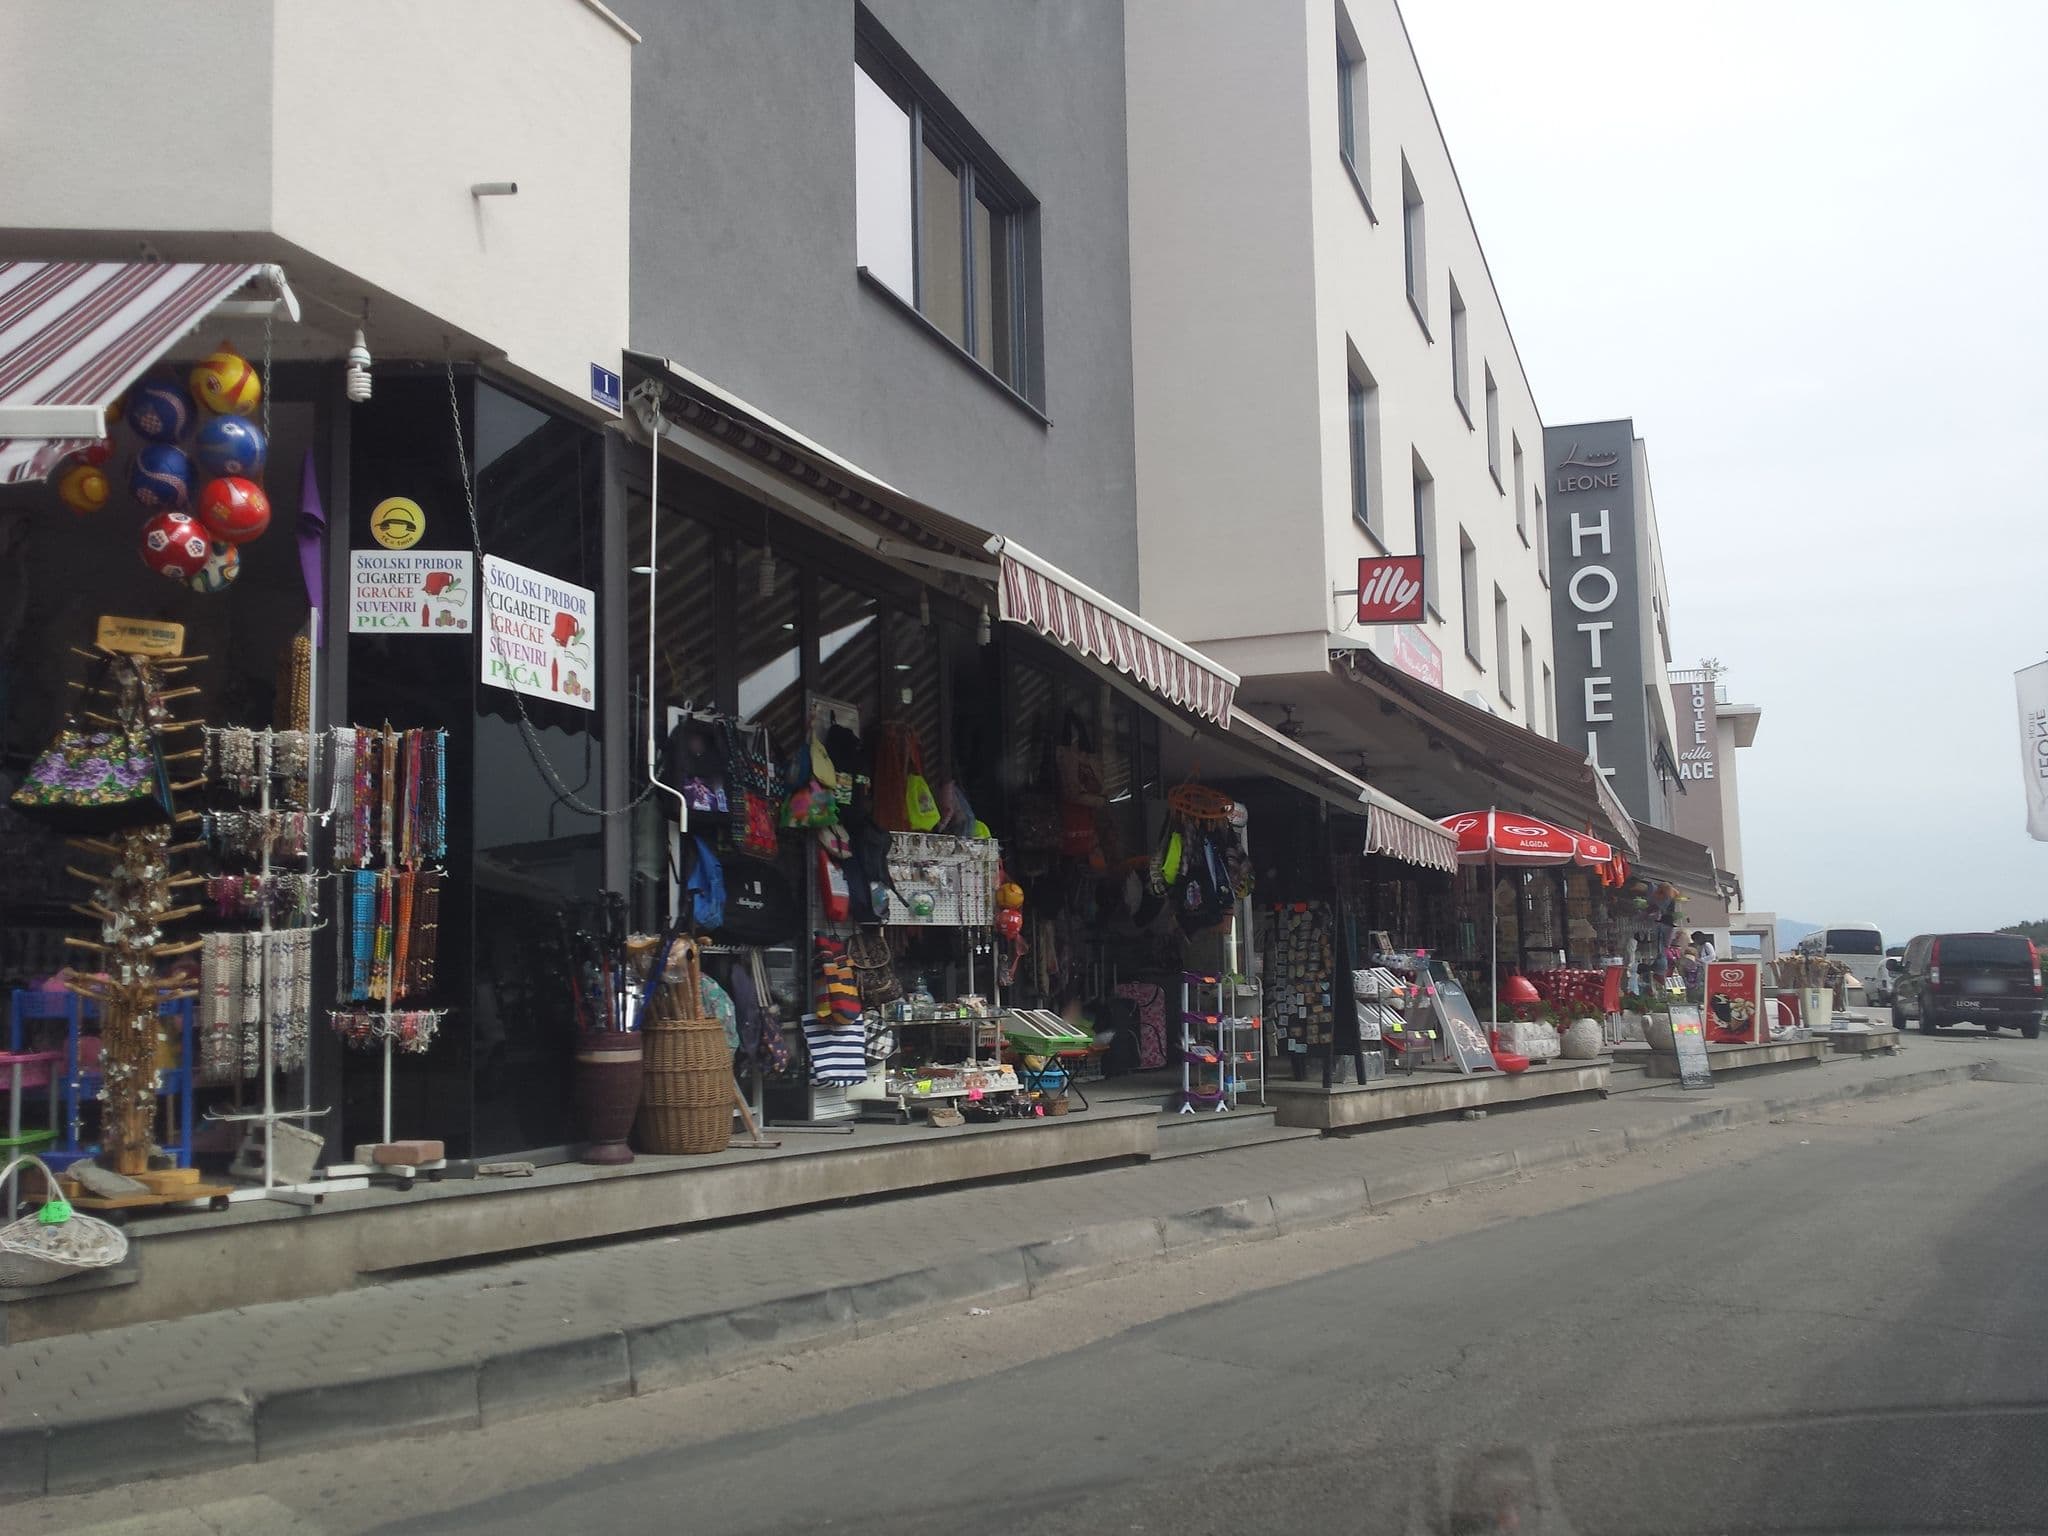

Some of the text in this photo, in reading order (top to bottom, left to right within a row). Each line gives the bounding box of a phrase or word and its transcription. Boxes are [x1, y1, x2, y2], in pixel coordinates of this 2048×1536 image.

[603, 374, 609, 394] 1
[1558, 472, 1619, 492] LEONE
[356, 555, 464, 569] ŠKOLSKI PRIBOR
[357, 572, 422, 584] CIGARETE
[357, 585, 414, 598] IGRAČKE
[490, 564, 587, 616] ŠKOLSKI PRIBOR
[1362, 565, 1420, 614] illy
[356, 601, 416, 613] SUVENIRI
[490, 591, 551, 626] CIGARETE
[357, 613, 410, 627] PIĆA
[491, 612, 545, 645] IGRAČKE
[490, 635, 547, 667] SUVENIRI
[1568, 510, 1618, 776] HOTEL
[1691, 683, 1707, 744] HOTEL
[1680, 746, 1713, 761] villa
[1520, 840, 1549, 848] ALGIDA
